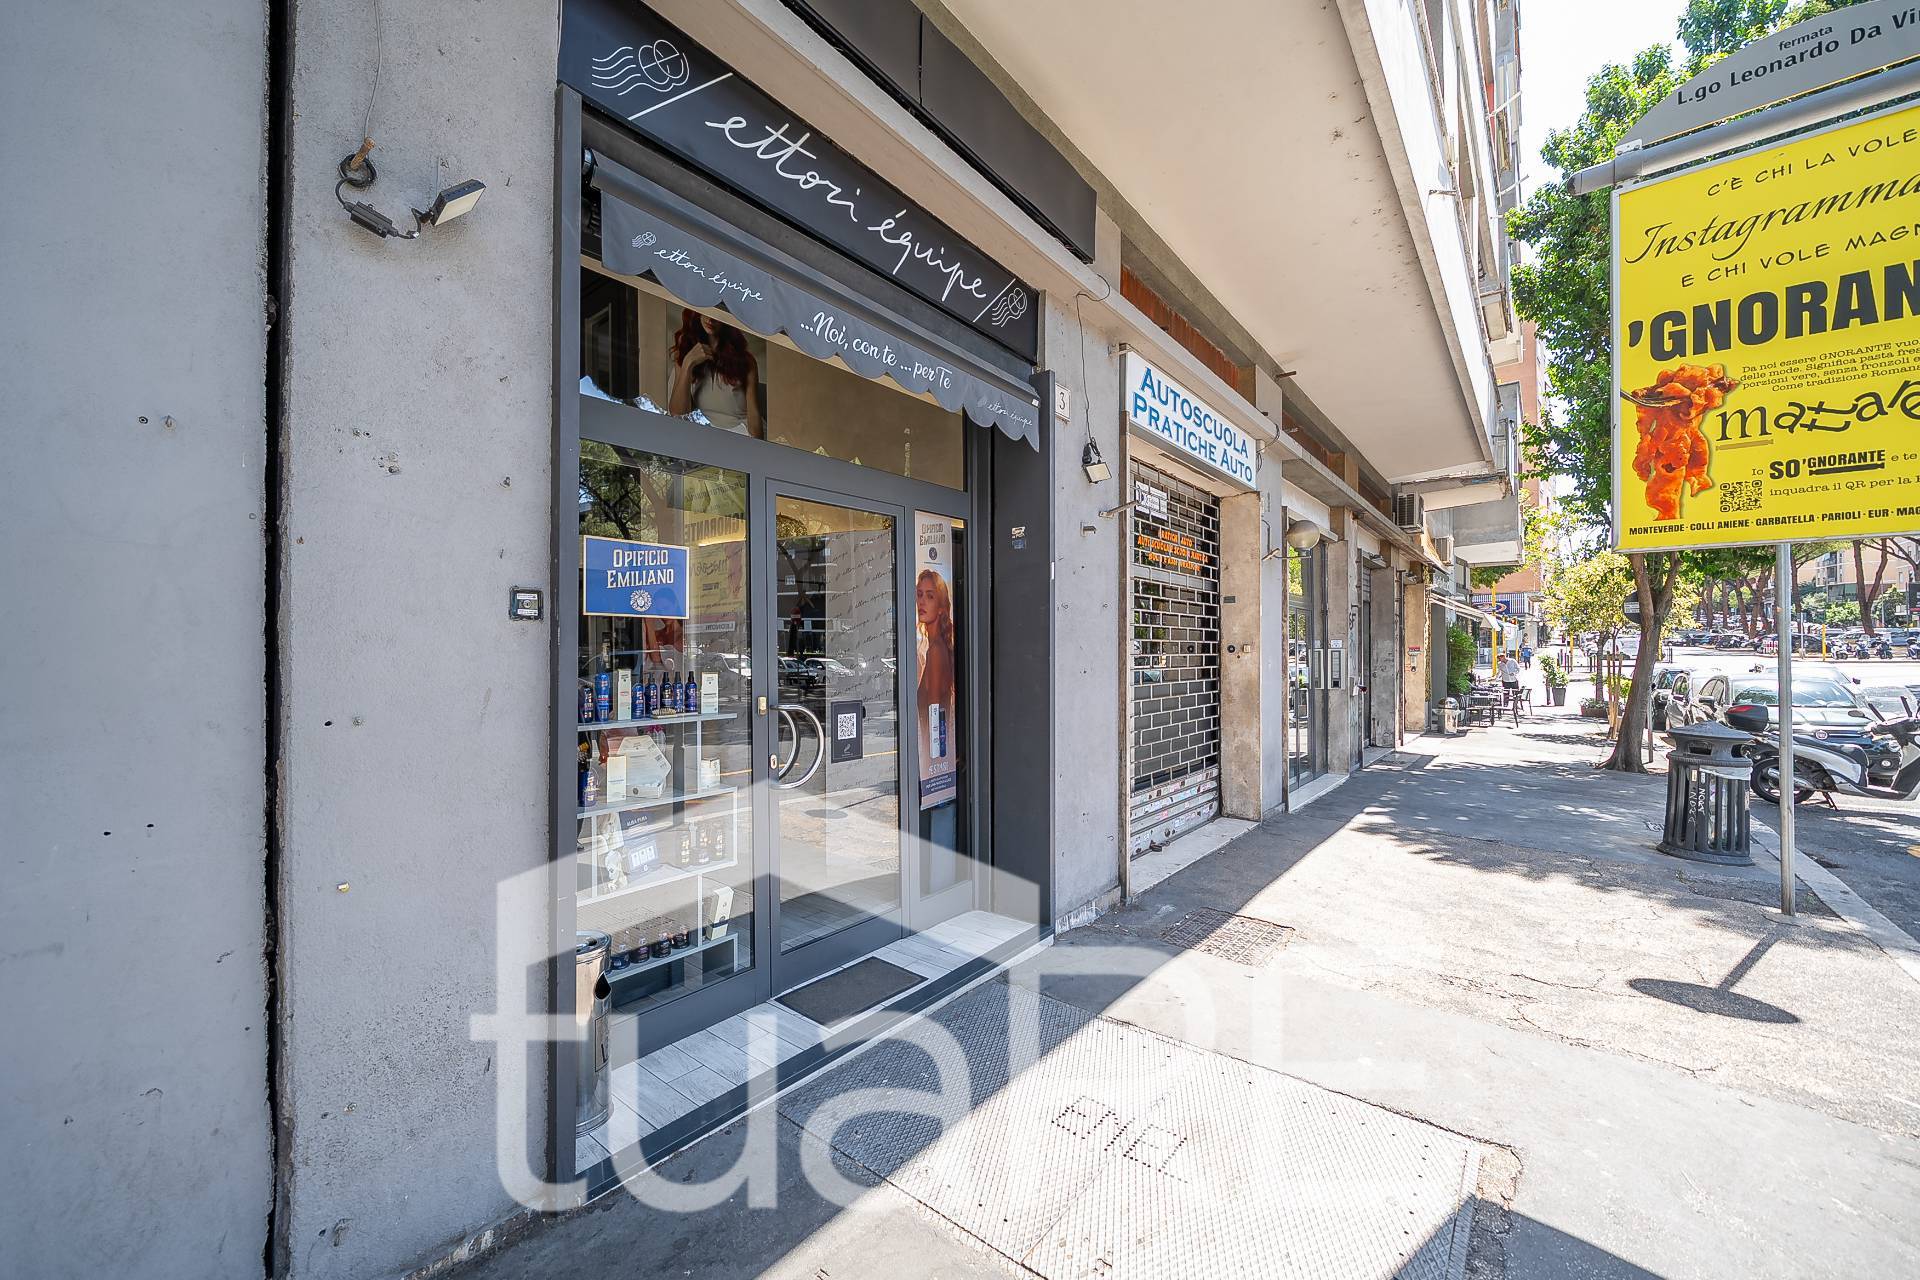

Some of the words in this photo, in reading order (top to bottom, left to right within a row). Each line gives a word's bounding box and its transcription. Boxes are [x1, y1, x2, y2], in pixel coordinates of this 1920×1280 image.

[1778, 25, 1833, 51] fermata
[1677, 81, 1721, 106] L.go
[1730, 40, 1839, 87] Leonardo
[1850, 25, 1882, 45] Da
[1891, 7, 1920, 30] Vi
[1755, 164, 1793, 184] CHI
[1805, 152, 1836, 171] LA
[1848, 129, 1918, 157] VOLE
[705, 116, 861, 222] ettori
[868, 209, 986, 302] équipe
[654, 249, 705, 278] ettori
[708, 272, 764, 301] équipe
[1681, 274, 1695, 288] E
[1707, 262, 1746, 281] CHI
[1760, 243, 1831, 270] VOLE
[852, 338, 881, 360] con
[882, 345, 898, 366] te
[935, 366, 953, 389] Te
[1740, 371, 1766, 382] delle
[1769, 366, 1802, 377] mode.
[1805, 357, 1857, 371] Significa
[1860, 352, 1894, 365] pasta
[1760, 362, 1777, 371] noi
[1780, 356, 1816, 367] essere
[1819, 342, 1892, 361] GNORANTE
[1895, 339, 1920, 348] vuo
[1743, 376, 1788, 390] porzioni
[1823, 366, 1858, 376] senza
[1861, 357, 1910, 371] fronzoli
[1772, 382, 1804, 392] Come
[1806, 373, 1868, 387] tradizione
[1059, 391, 1066, 410] 3
[1140, 366, 1248, 459] AUTOSCUOLA
[1133, 392, 1217, 464] PRATICHE
[1220, 448, 1253, 482] AUTO
[1770, 484, 1830, 496] inquadra
[1833, 482, 1841, 491] il
[1845, 480, 1866, 490] QR
[1869, 479, 1895, 489] per
[1898, 476, 1911, 485] la
[1629, 523, 1685, 536] MONTEVERDE
[1690, 521, 1715, 531] COLLI
[1717, 518, 1750, 530] ANIENE
[1755, 514, 1815, 527] GARBATELLA
[1821, 510, 1861, 522] PARIOLI
[1868, 508, 1889, 519] EUR
[613, 548, 669, 568] OPIFICIO
[606, 568, 674, 589] EMILIANO
